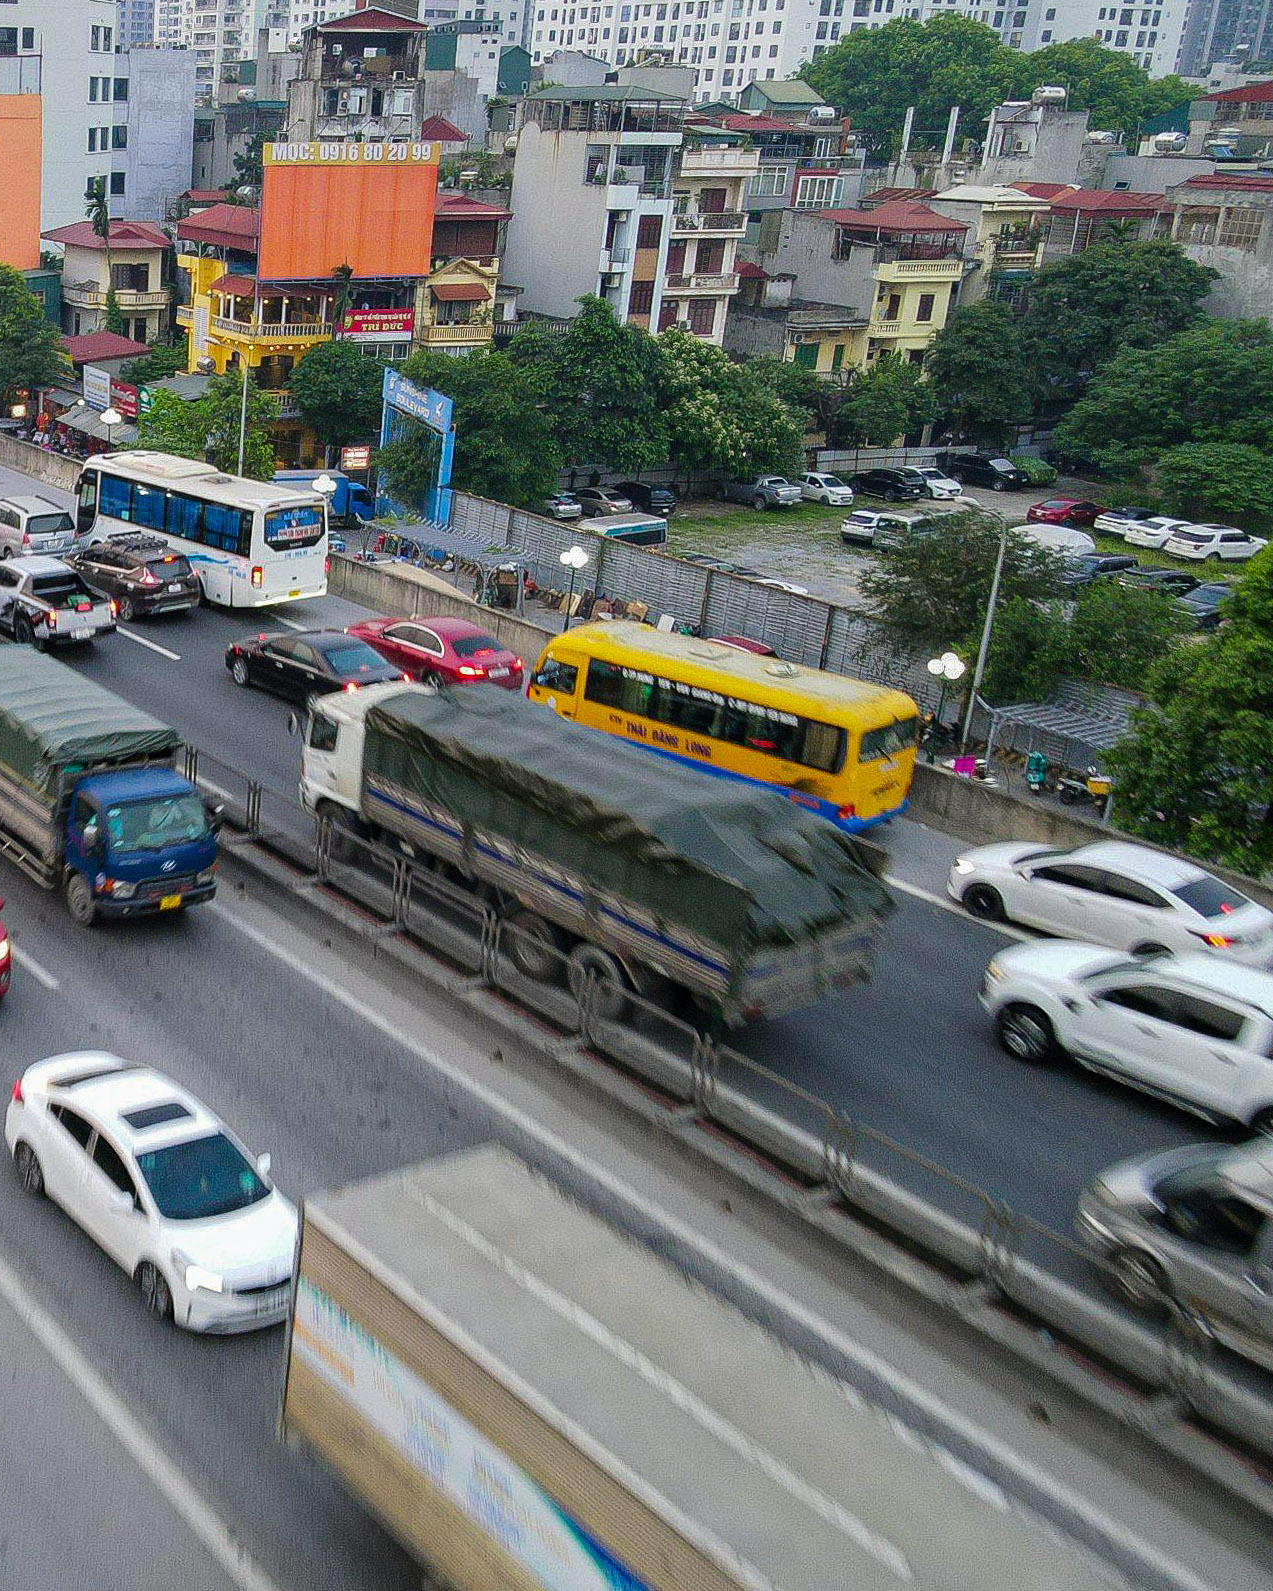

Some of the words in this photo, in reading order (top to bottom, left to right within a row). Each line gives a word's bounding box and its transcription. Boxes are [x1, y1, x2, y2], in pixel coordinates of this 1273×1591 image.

[271, 143, 315, 161] MQC:
[319, 143, 360, 161] 0916
[363, 143, 383, 161] 80
[387, 143, 407, 161] 20
[411, 143, 431, 161] 99
